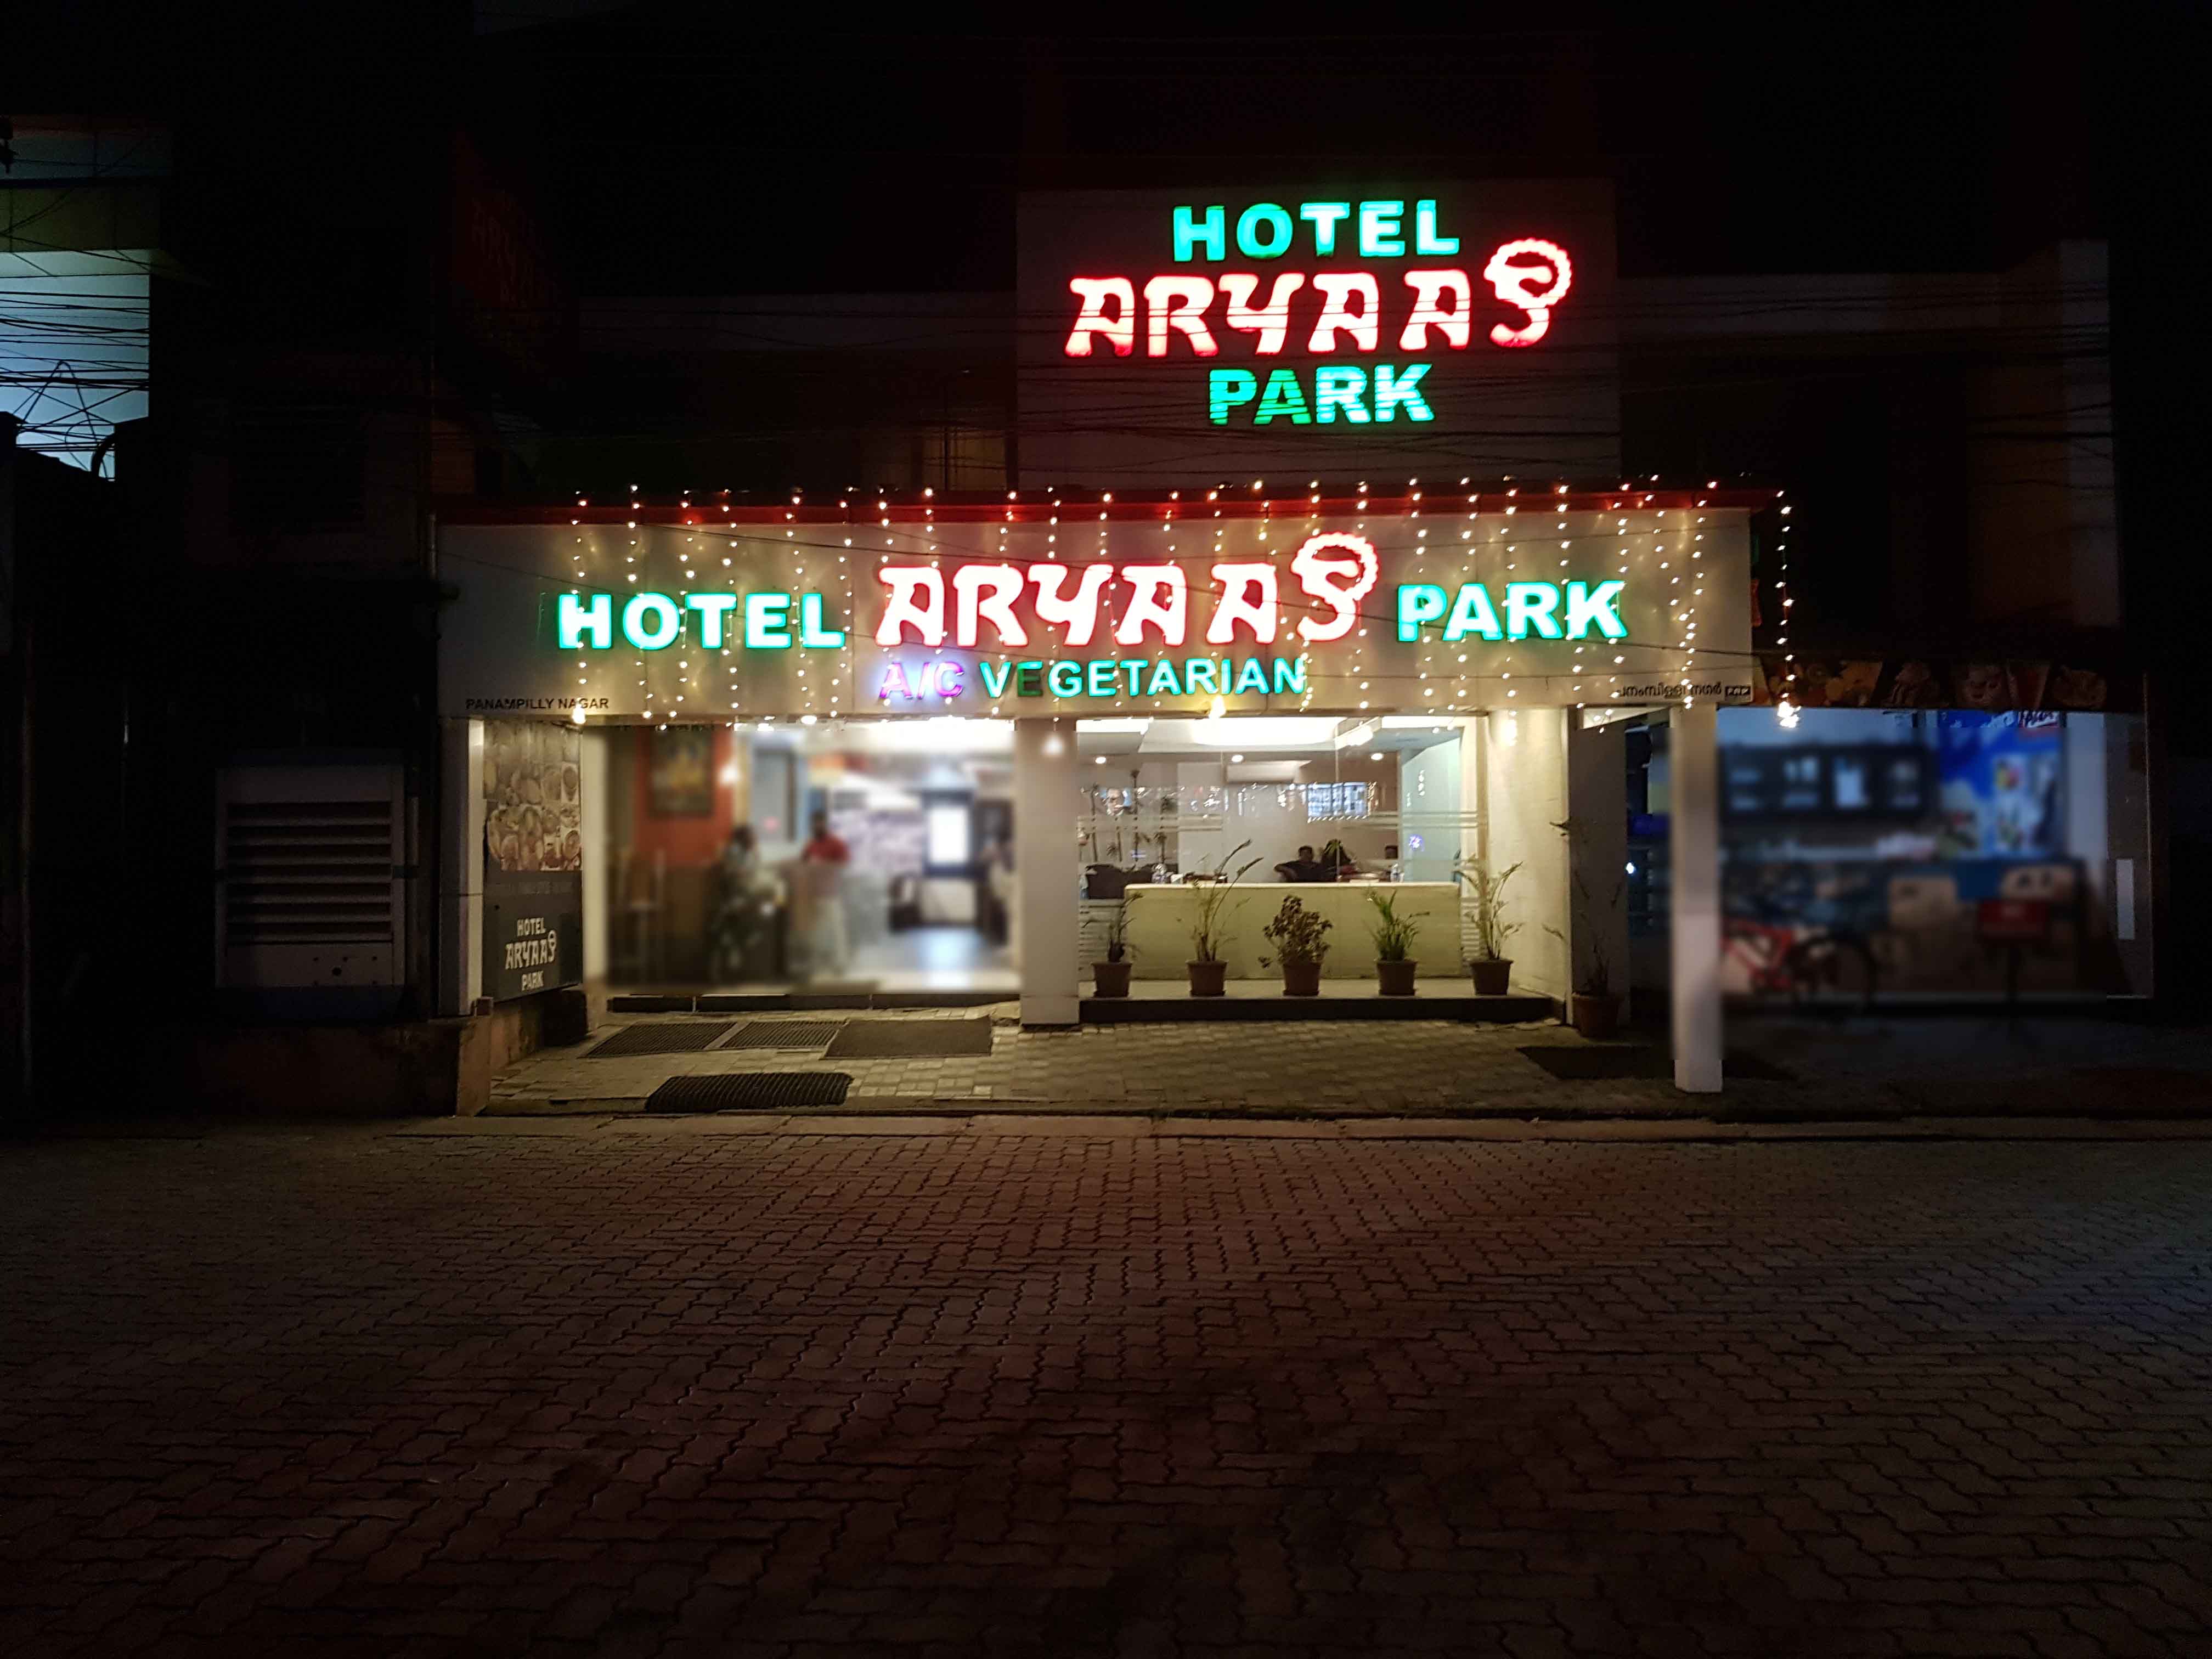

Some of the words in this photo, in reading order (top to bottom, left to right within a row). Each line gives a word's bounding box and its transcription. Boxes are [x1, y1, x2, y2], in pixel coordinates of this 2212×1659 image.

[1173, 200, 1460, 262] HOTEL
[1064, 238, 1573, 358] ARYAAS
[1209, 364, 1435, 424] PARK
[558, 593, 845, 650] HOTEL
[873, 532, 1379, 647] ARYAAS
[1397, 580, 1628, 642] PARK
[879, 662, 964, 699] A/C
[979, 658, 1306, 698] VEGETARIAN
[466, 698, 554, 710] PANAMPILLY
[558, 698, 609, 709] NAGAR
[517, 917, 547, 936] HOTEL
[505, 929, 557, 970] ARYAAS
[521, 970, 544, 991] PARK
